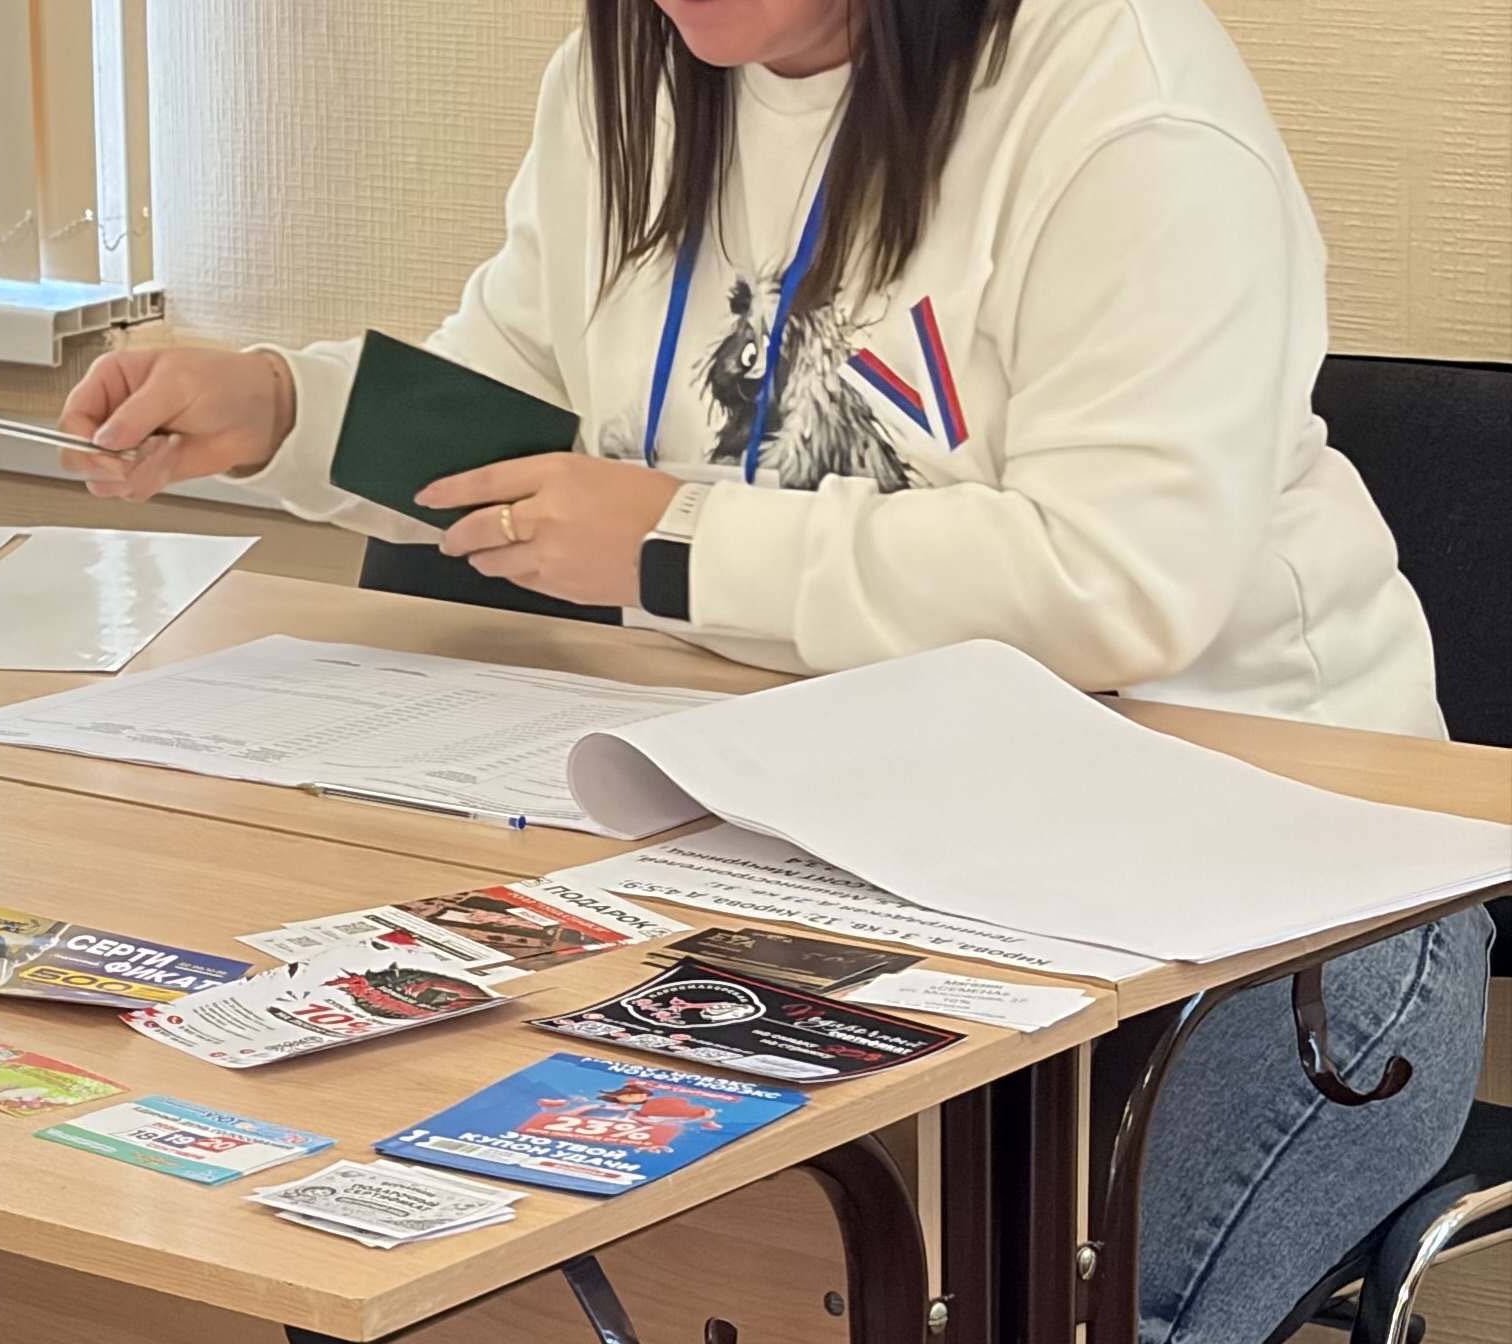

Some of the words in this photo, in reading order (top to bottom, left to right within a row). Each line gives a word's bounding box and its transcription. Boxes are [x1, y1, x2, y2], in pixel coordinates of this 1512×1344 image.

[543, 885, 658, 930] ПОДАРОК
[711, 895, 802, 918] Кирова,
[66, 935, 179, 968] СЕРТИ
[957, 941, 1053, 966] Кирова,
[104, 961, 224, 991] ФИКАТ
[292, 1003, 373, 1034] 10%
[162, 1133, 196, 1145] 19
[195, 1137, 237, 1150] 20
[543, 1116, 653, 1141] 23%
[458, 1132, 552, 1154] КУПОН
[551, 1149, 642, 1172] УДАЧИ
[499, 1131, 552, 1146] ЭТО
[556, 1140, 628, 1159] ТВОЙ
